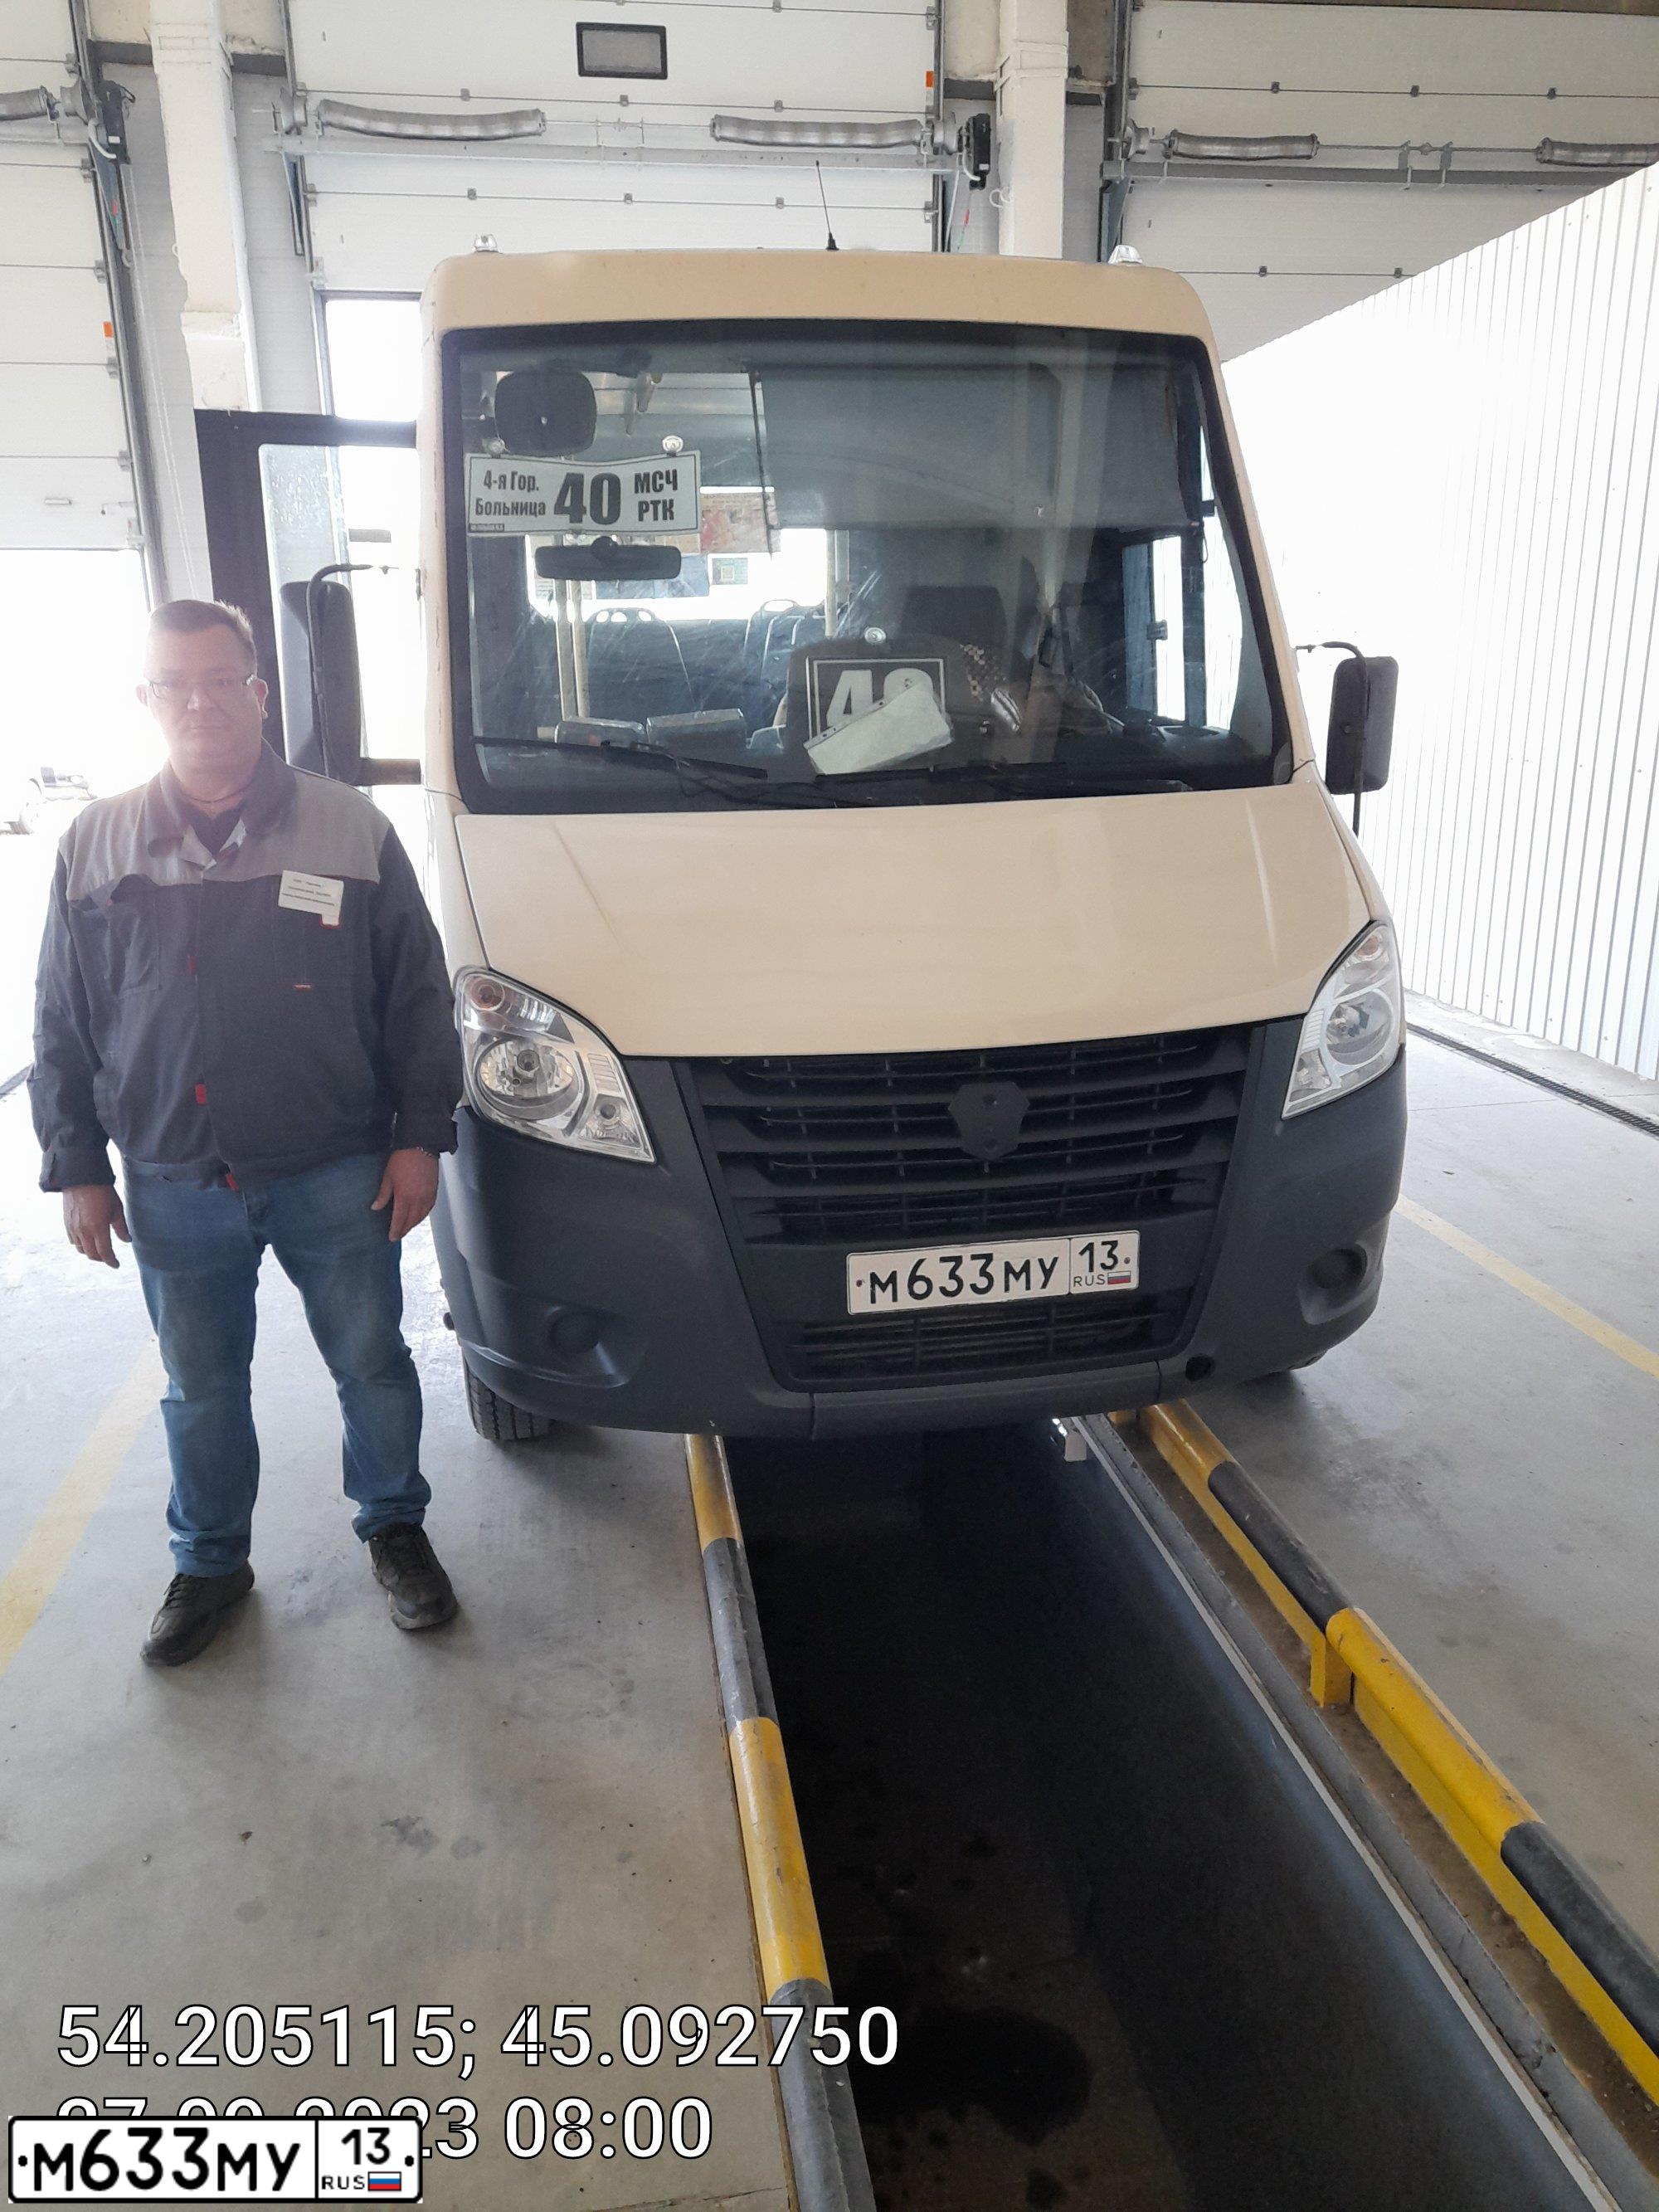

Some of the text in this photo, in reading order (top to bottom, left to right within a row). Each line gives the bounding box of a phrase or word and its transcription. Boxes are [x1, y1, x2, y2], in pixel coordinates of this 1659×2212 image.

[483, 470, 539, 492] 4-я Гор.
[634, 469, 679, 495] МСЧ
[475, 498, 546, 518] Больница
[553, 471, 622, 525] 40
[637, 499, 675, 522] РТК
[869, 1240, 1119, 1304] М633МУ 13
[1073, 1274, 1106, 1287] RUS
